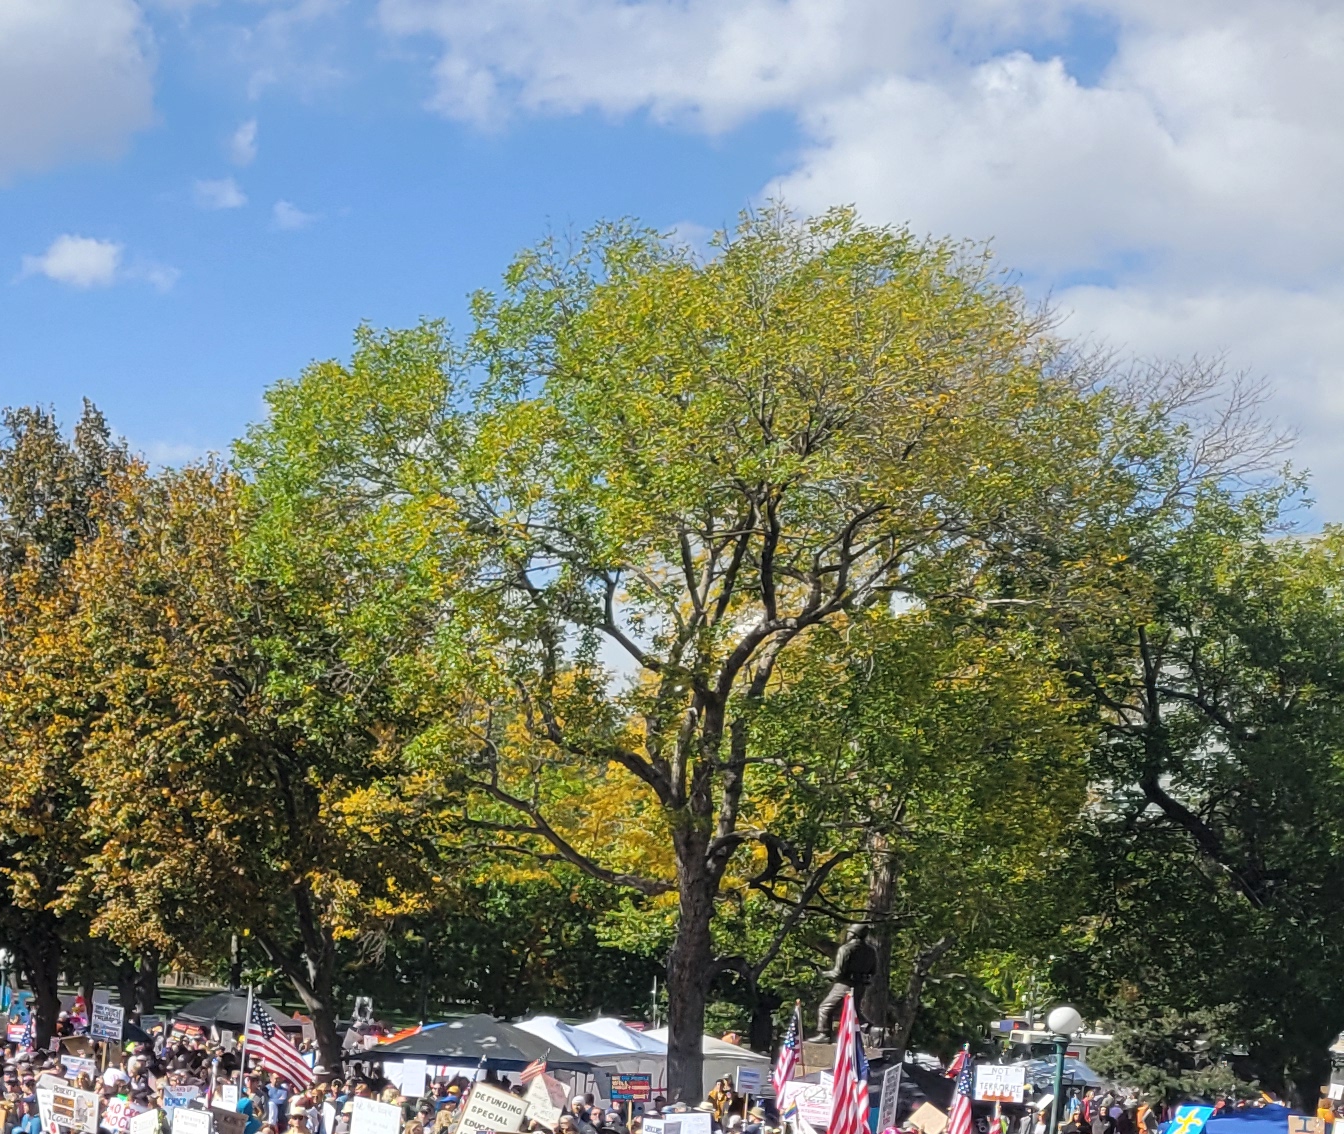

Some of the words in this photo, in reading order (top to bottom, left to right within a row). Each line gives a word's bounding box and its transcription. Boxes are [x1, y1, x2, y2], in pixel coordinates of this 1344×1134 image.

[474, 1090, 523, 1116] DEFUNDING
[470, 1105, 508, 1126] SPECIAL
[1294, 1117, 1315, 1133] I
